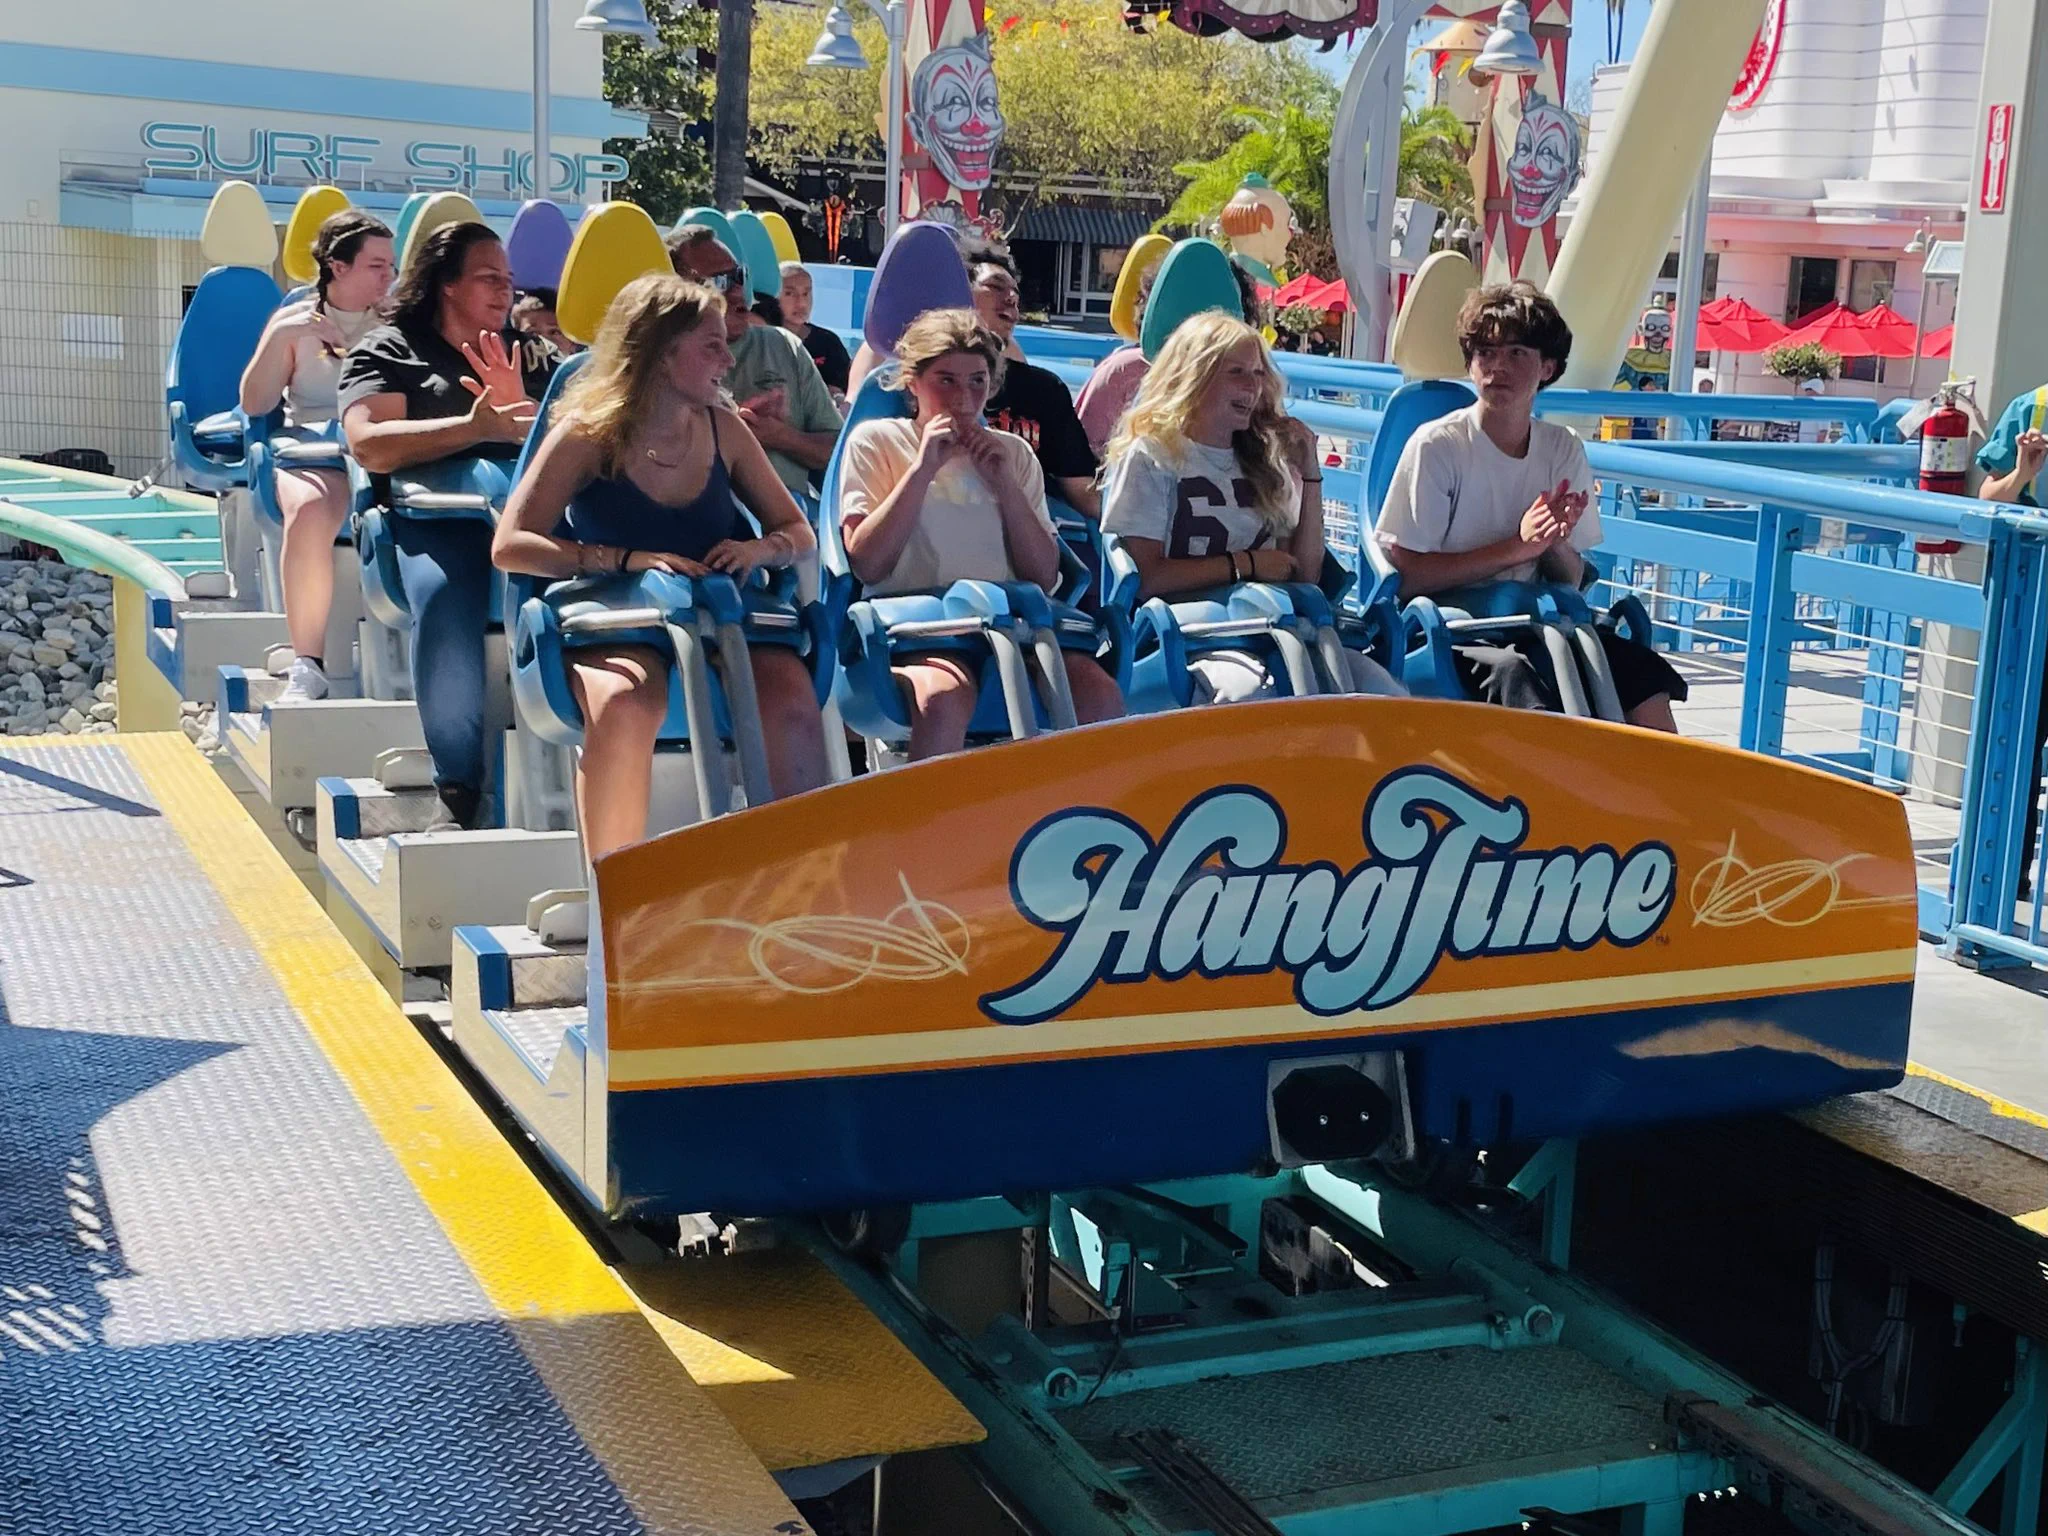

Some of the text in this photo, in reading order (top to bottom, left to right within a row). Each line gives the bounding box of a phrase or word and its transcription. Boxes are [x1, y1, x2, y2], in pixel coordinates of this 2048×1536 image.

[143, 121, 630, 195] SURF SHOP
[978, 766, 1676, 1025] HangTime
